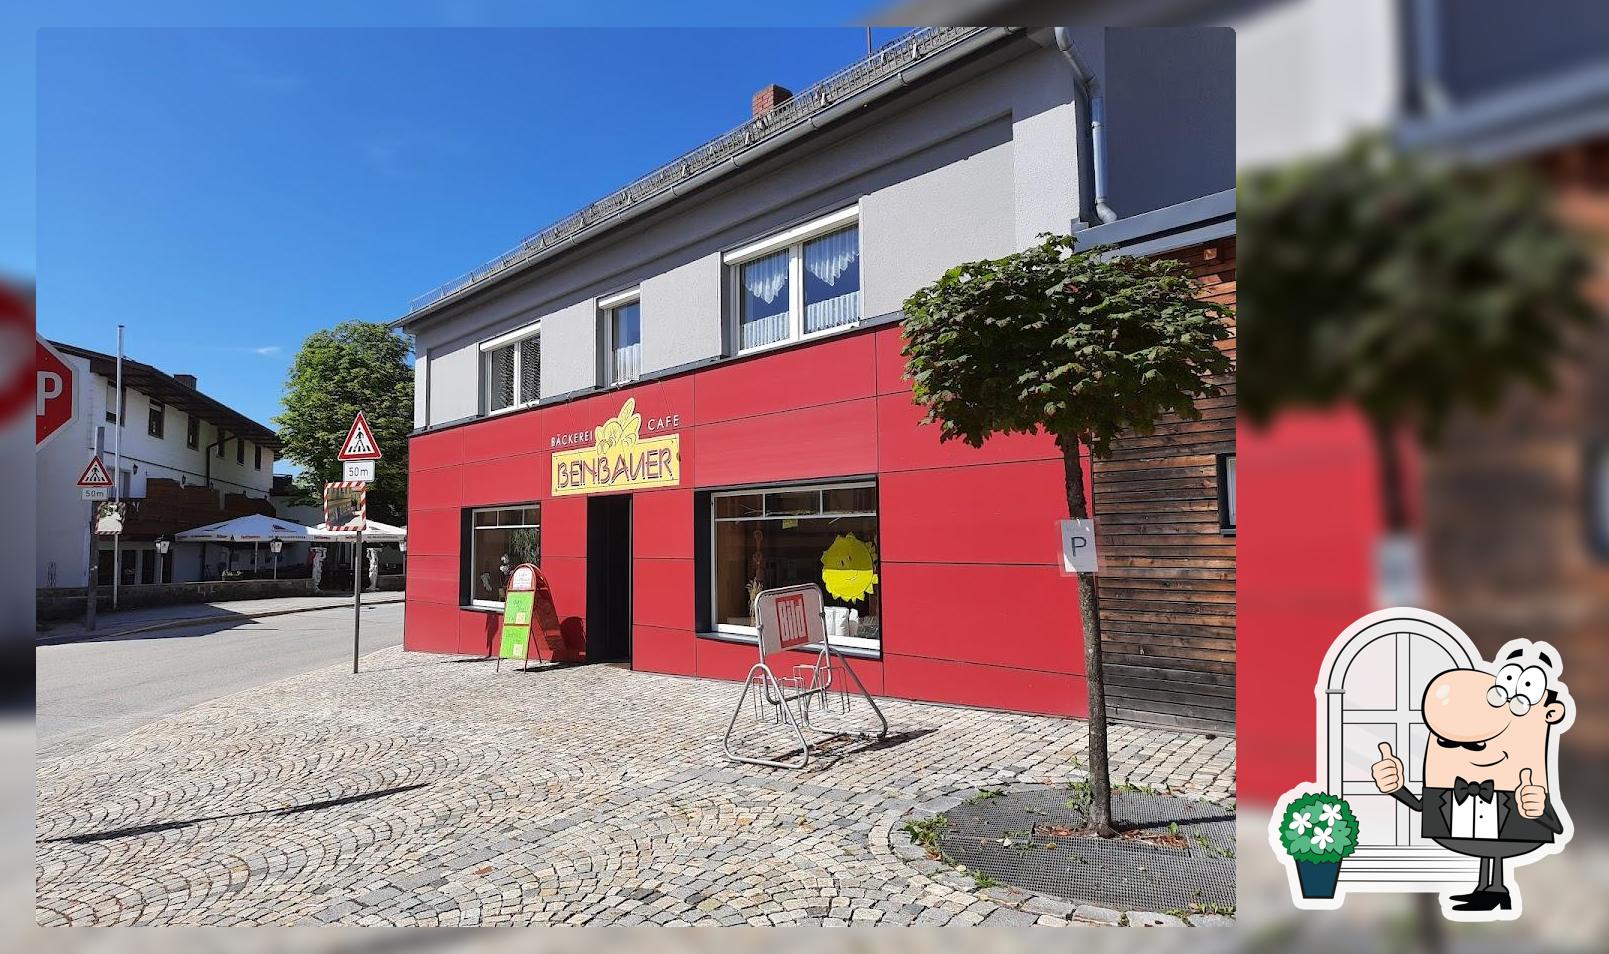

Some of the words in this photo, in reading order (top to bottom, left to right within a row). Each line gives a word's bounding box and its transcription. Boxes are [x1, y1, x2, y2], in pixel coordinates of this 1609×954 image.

[647, 414, 680, 431] CAFE
[551, 430, 593, 447] BÄCKEREI
[557, 447, 673, 488] BEINBAUER
[1071, 536, 1087, 557] P
